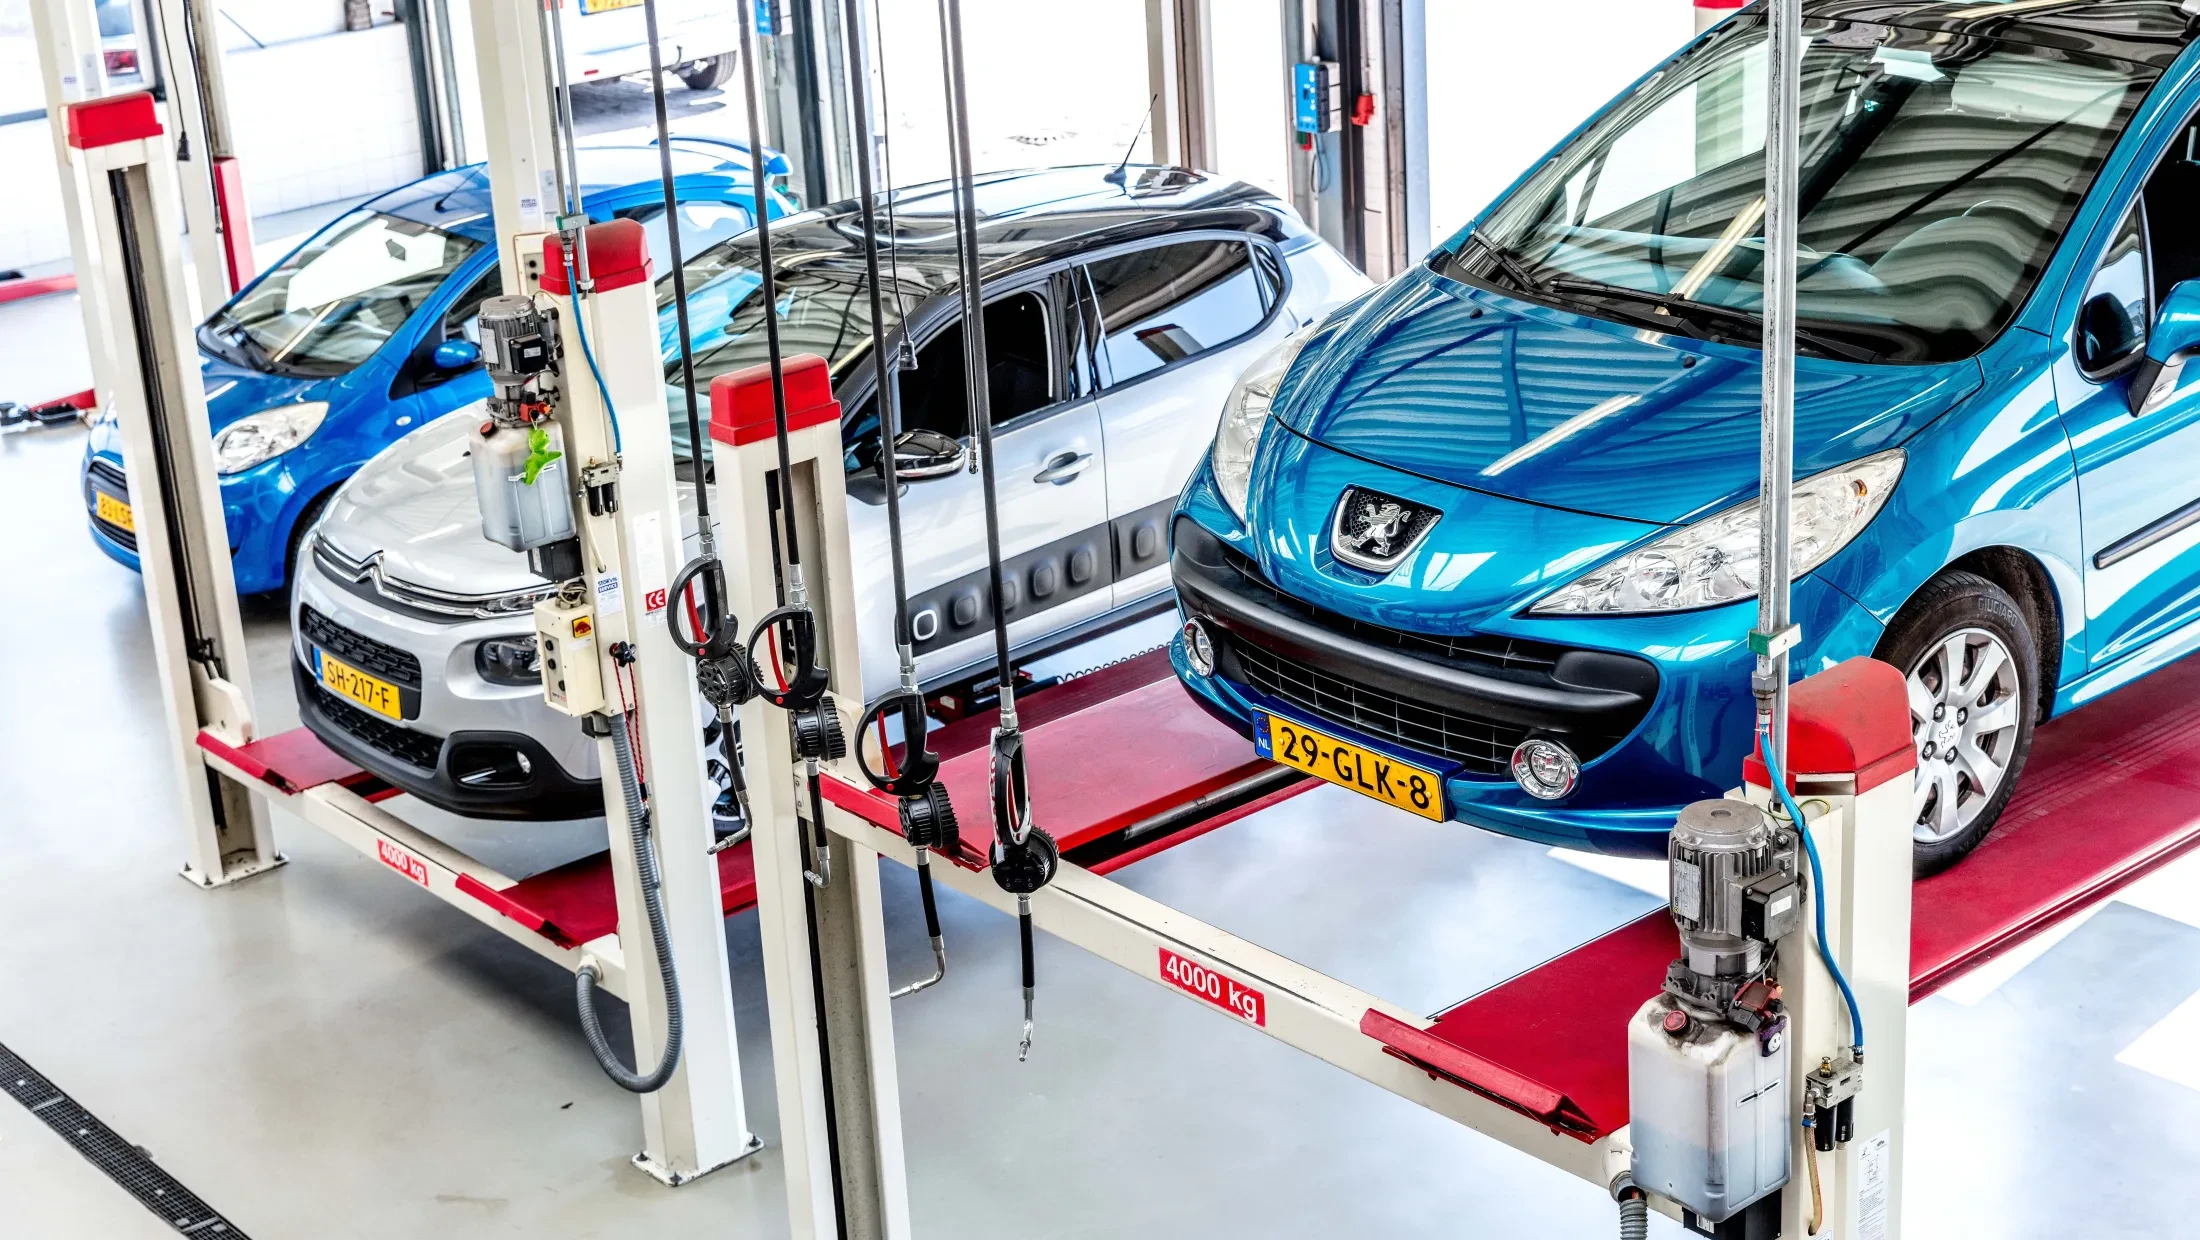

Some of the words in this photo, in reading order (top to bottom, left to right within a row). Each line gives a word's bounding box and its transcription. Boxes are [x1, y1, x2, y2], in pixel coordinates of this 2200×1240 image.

[648, 590, 665, 608] CE
[1978, 597, 2018, 627] GIUGIARO
[327, 661, 389, 709] SH-217-F
[1258, 737, 1271, 751] NL
[1281, 726, 1430, 810] 29-GLK-8
[381, 842, 408, 870] 4000
[410, 857, 425, 884] kg
[1166, 955, 1220, 999] 4000
[1229, 981, 1257, 1022] kg
